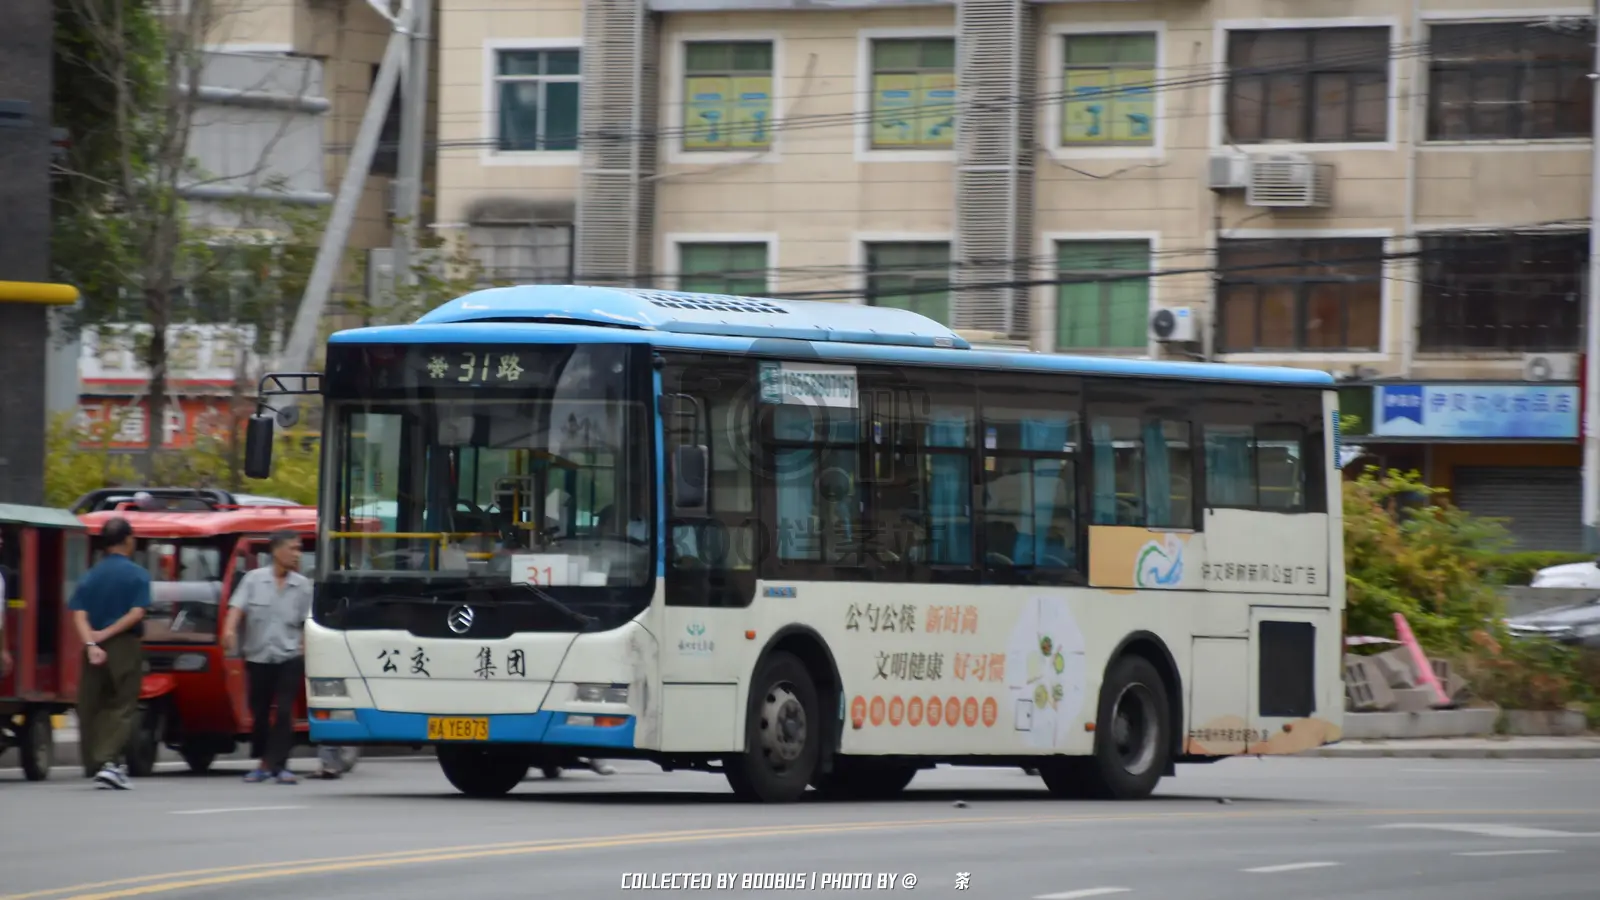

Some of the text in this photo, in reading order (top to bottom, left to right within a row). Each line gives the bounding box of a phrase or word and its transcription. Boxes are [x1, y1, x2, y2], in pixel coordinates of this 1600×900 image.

[458, 352, 524, 382] 31路
[526, 565, 553, 586] 31
[844, 602, 979, 635] 公勺公筷 新时尚
[376, 646, 527, 680] 公交 集团
[872, 649, 1006, 683] 文明健康 好习惯
